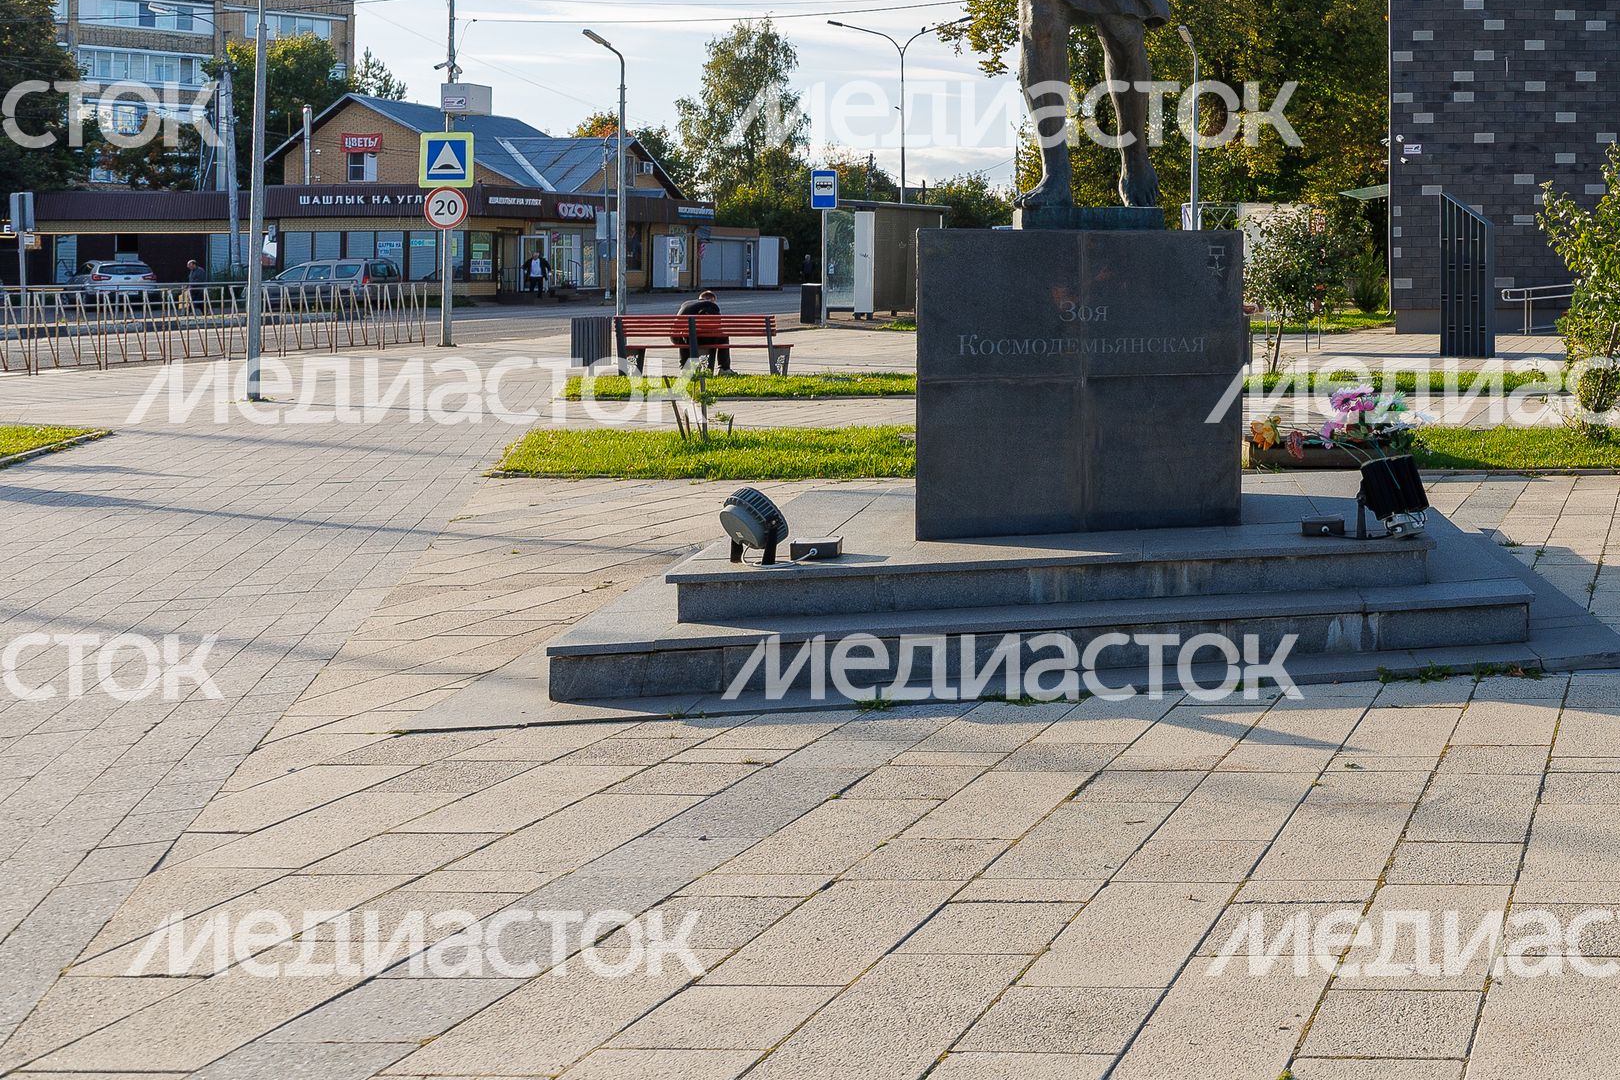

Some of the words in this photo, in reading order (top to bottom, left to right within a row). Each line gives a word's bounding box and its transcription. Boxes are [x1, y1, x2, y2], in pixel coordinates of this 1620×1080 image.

[345, 137, 379, 149] ЦВЕТЫ
[299, 195, 366, 205] ШАШЛЫК
[372, 195, 391, 205] НА
[397, 195, 428, 205] УГЛ
[434, 200, 458, 216] 20
[558, 202, 594, 219] OZON
